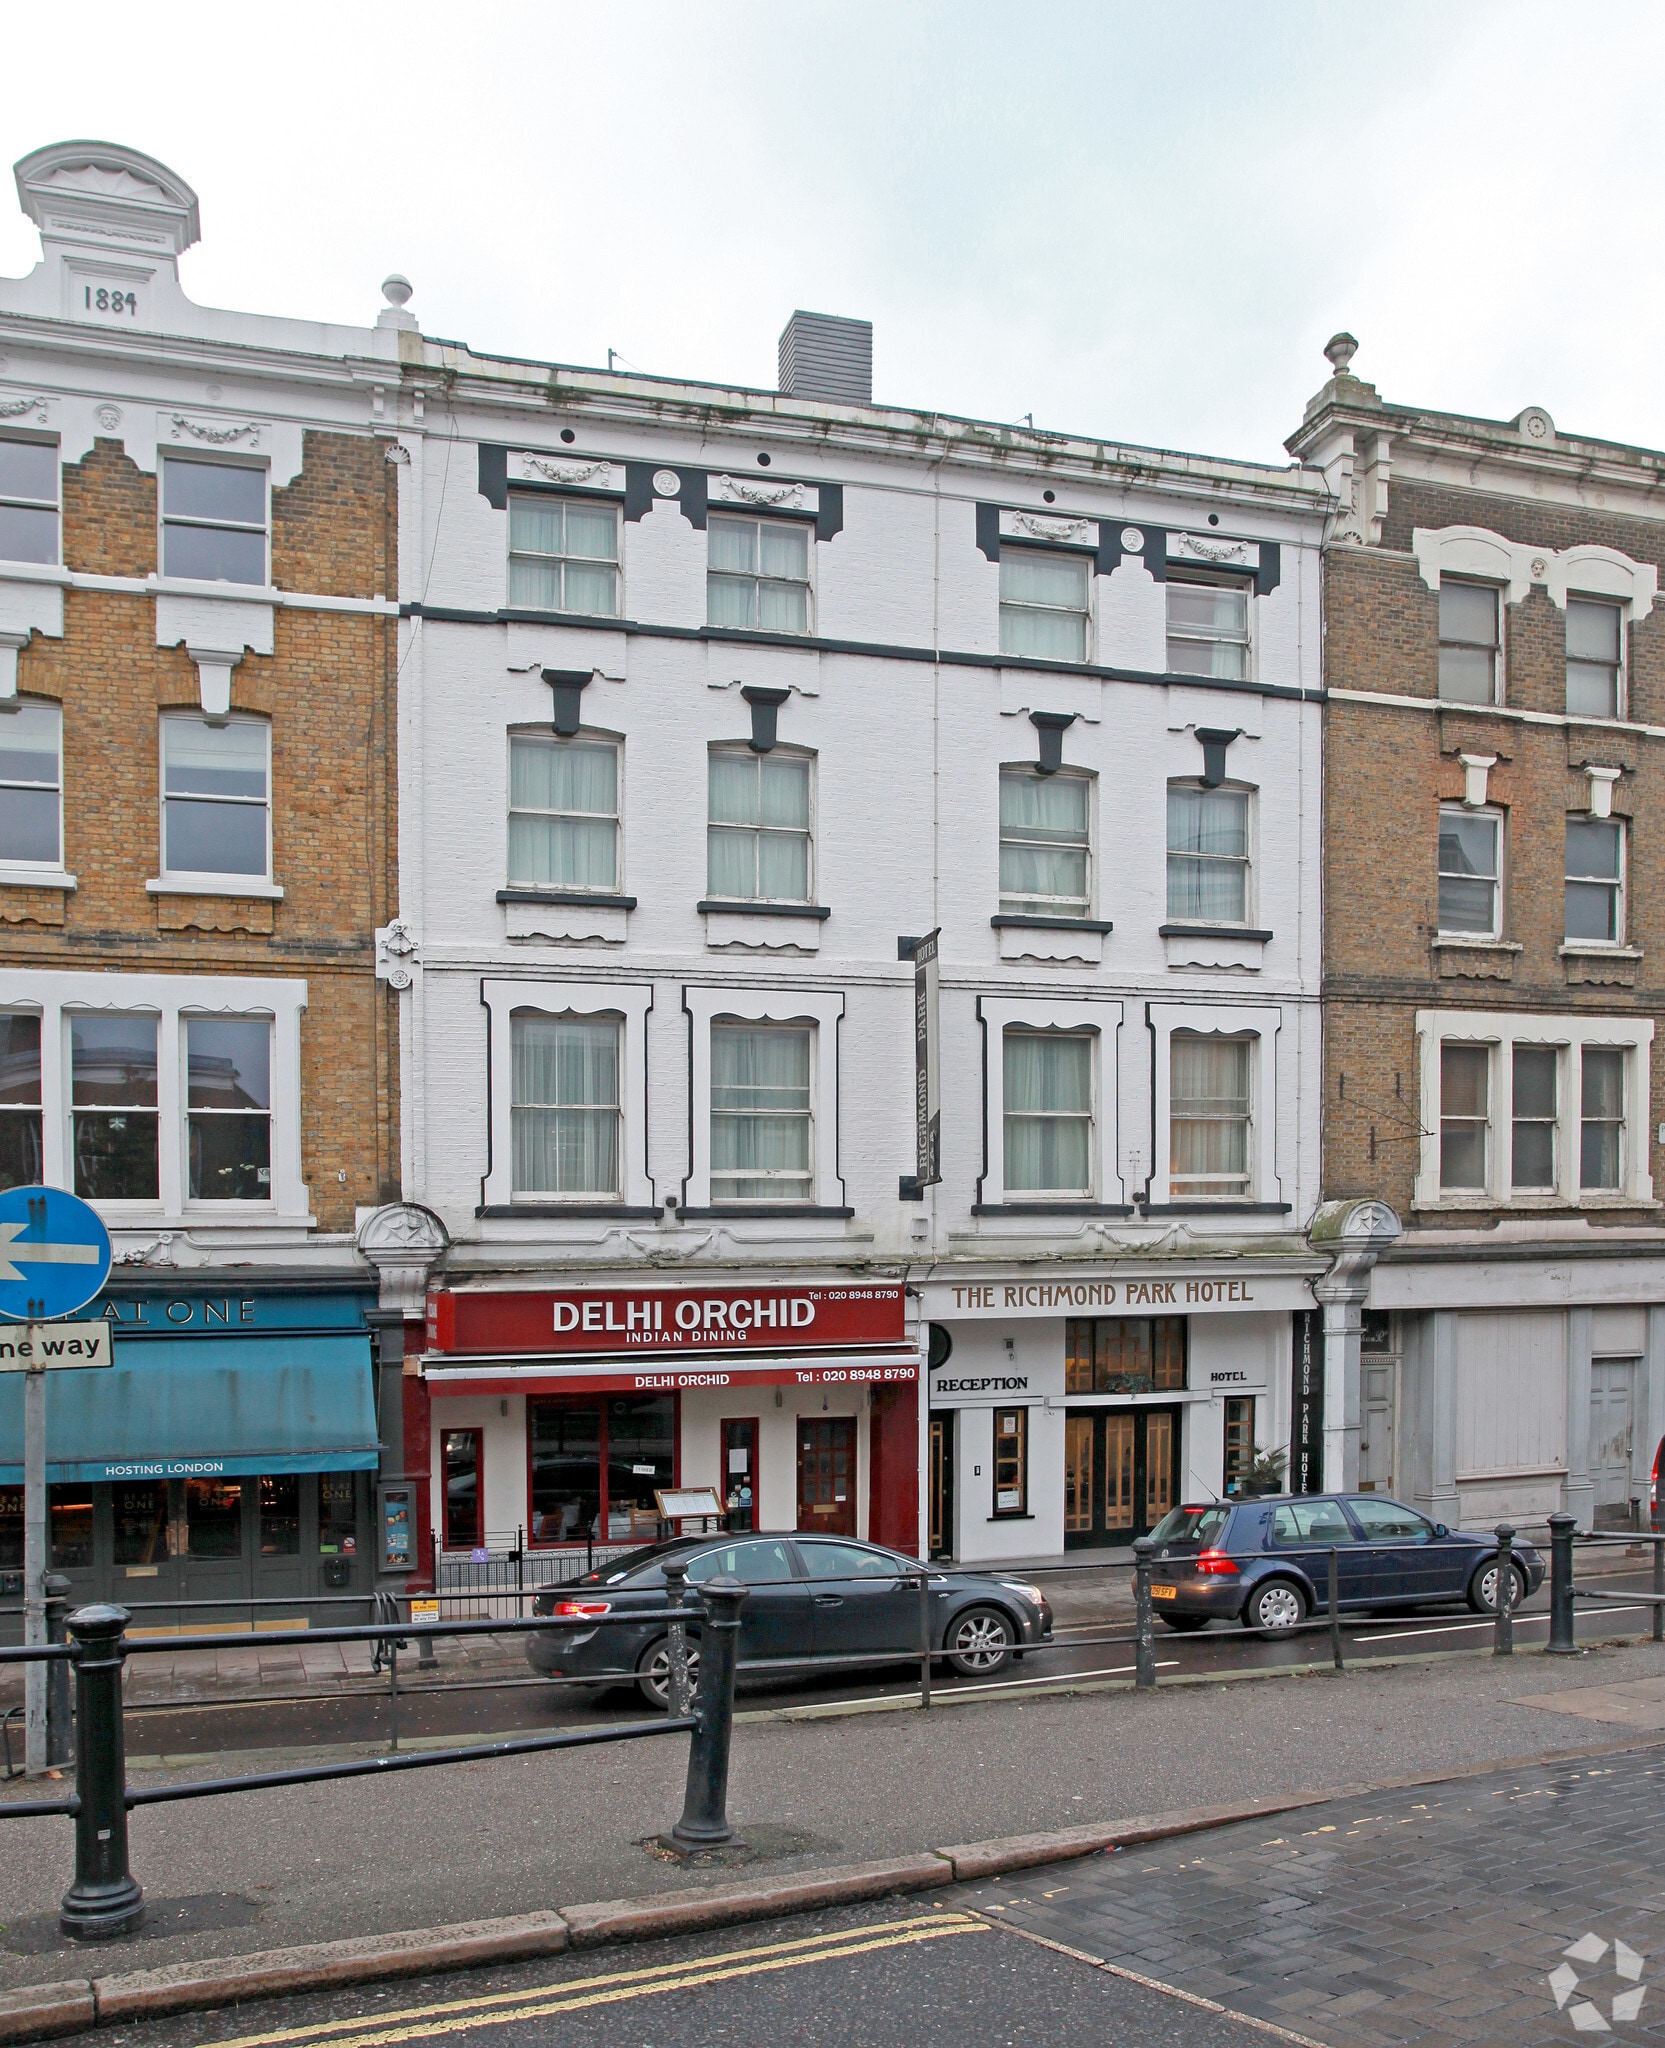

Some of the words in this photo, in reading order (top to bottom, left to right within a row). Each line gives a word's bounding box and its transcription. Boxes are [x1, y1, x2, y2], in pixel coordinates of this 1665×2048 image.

[85, 285, 137, 317] 1884
[916, 940, 936, 963] HOTEL
[917, 991, 926, 1042] PARK
[918, 1068, 927, 1168] RICHMOND
[808, 1291, 822, 1300] Tel
[828, 1291, 847, 1300] 020
[848, 1290, 873, 1300] 8948
[874, 1290, 899, 1299] 8790
[951, 1286, 996, 1308] THE
[1003, 1283, 1116, 1307] RICHMOND
[1125, 1282, 1177, 1305] PARK
[1185, 1281, 1254, 1303] HOTEL
[102, 1299, 149, 1324] AT
[166, 1299, 255, 1324] ONE
[553, 1300, 663, 1332] DELHI
[674, 1298, 816, 1330] ORCHID
[626, 1331, 682, 1343] INDIAN
[691, 1329, 747, 1342] DINING
[0, 1342, 33, 1358] ne
[41, 1339, 100, 1359] way
[1302, 1312, 1311, 1396] RICHMOND
[635, 1375, 675, 1388] DELHI
[678, 1373, 730, 1386] ORCHID
[795, 1371, 813, 1382] Tel
[822, 1370, 847, 1381] 020
[849, 1369, 881, 1380] 8948
[883, 1367, 915, 1379] 8790
[936, 1377, 1028, 1392] RECEPTION
[1210, 1371, 1247, 1381] HOTEL
[1301, 1402, 1309, 1445] PARK
[105, 1464, 163, 1476] HOSTING
[167, 1462, 223, 1473] LONDON
[1301, 1452, 1309, 1493] HOTE
[124, 1499, 154, 1510] ONE
[322, 1490, 351, 1499] ONE
